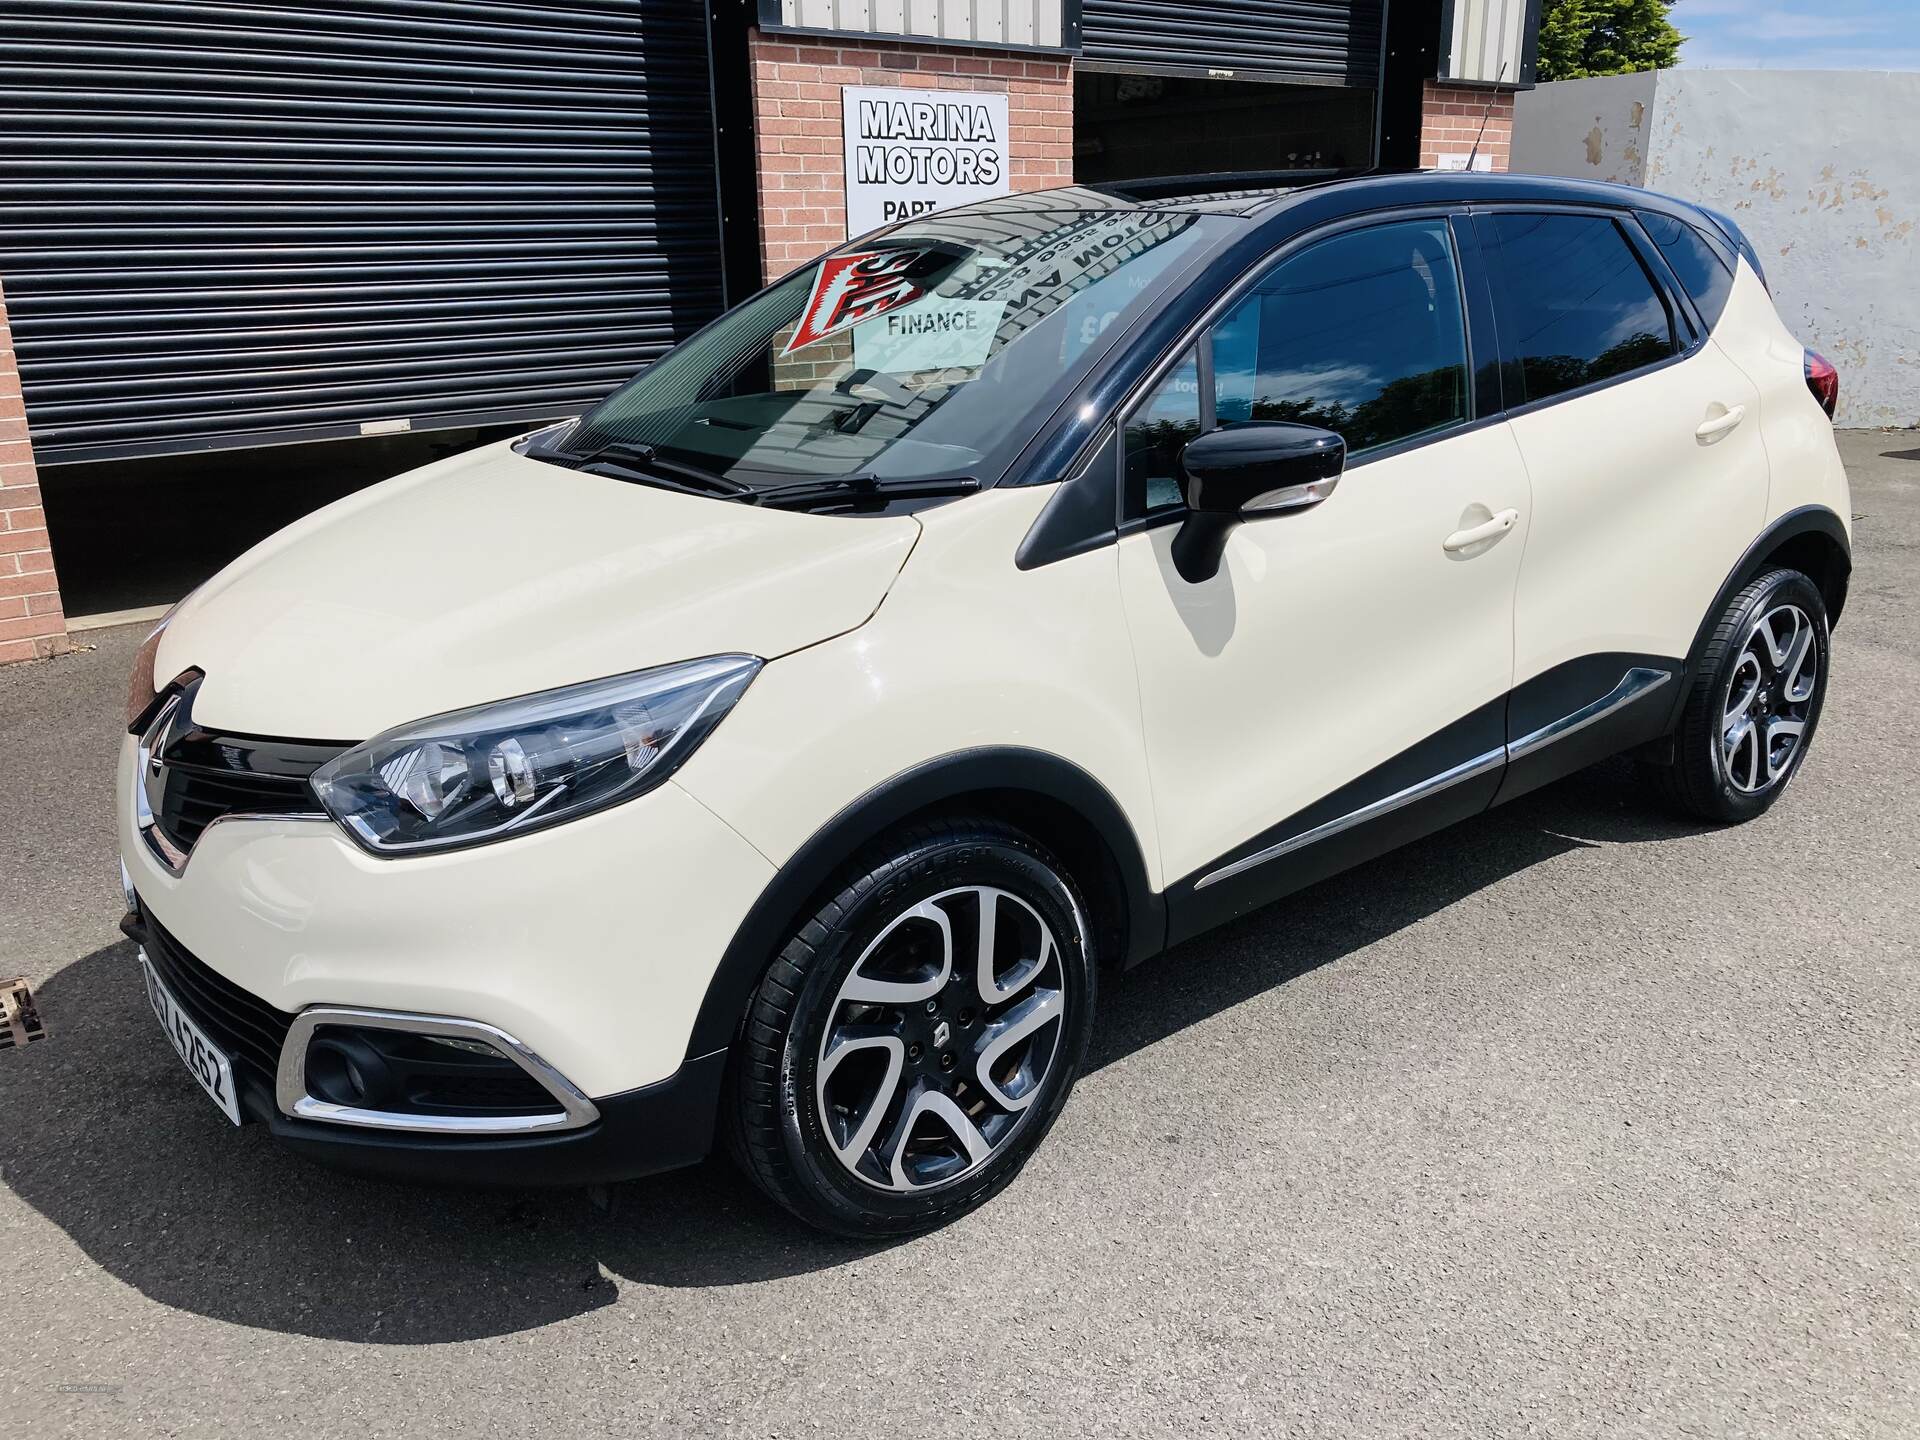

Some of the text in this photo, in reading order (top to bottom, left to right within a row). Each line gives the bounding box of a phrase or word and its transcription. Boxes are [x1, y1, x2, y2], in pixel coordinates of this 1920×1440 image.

[859, 100, 996, 142] MARINA
[857, 146, 1000, 185] MOTORS
[883, 200, 936, 221] PART
[888, 310, 978, 336] FINANCE
[175, 1010, 227, 1106] 4262
